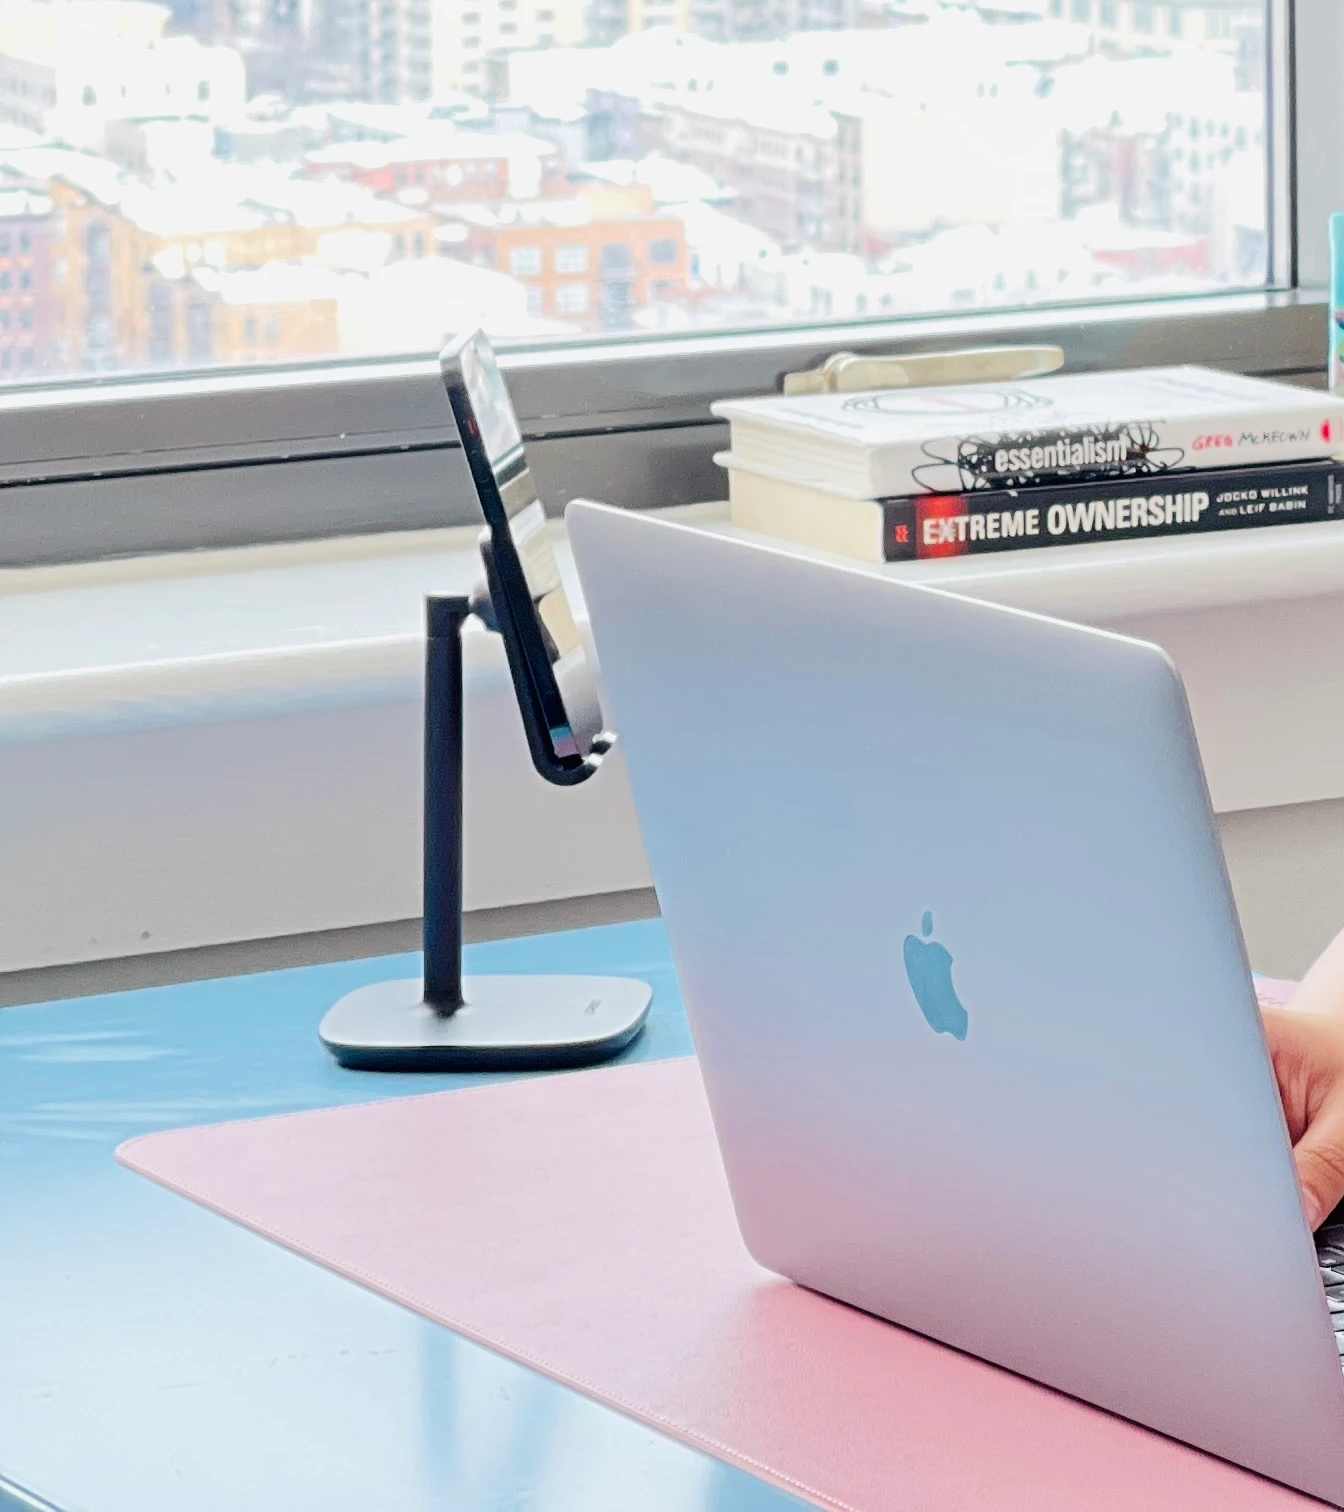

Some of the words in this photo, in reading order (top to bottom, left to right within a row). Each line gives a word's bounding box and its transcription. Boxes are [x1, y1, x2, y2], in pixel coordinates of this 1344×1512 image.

[994, 436, 1128, 473] essentialism
[1215, 488, 1258, 503] JOCKO
[1260, 485, 1309, 499] WILLINK
[922, 508, 1040, 546] EXTREME
[1047, 491, 1210, 536] OWNERSHIP
